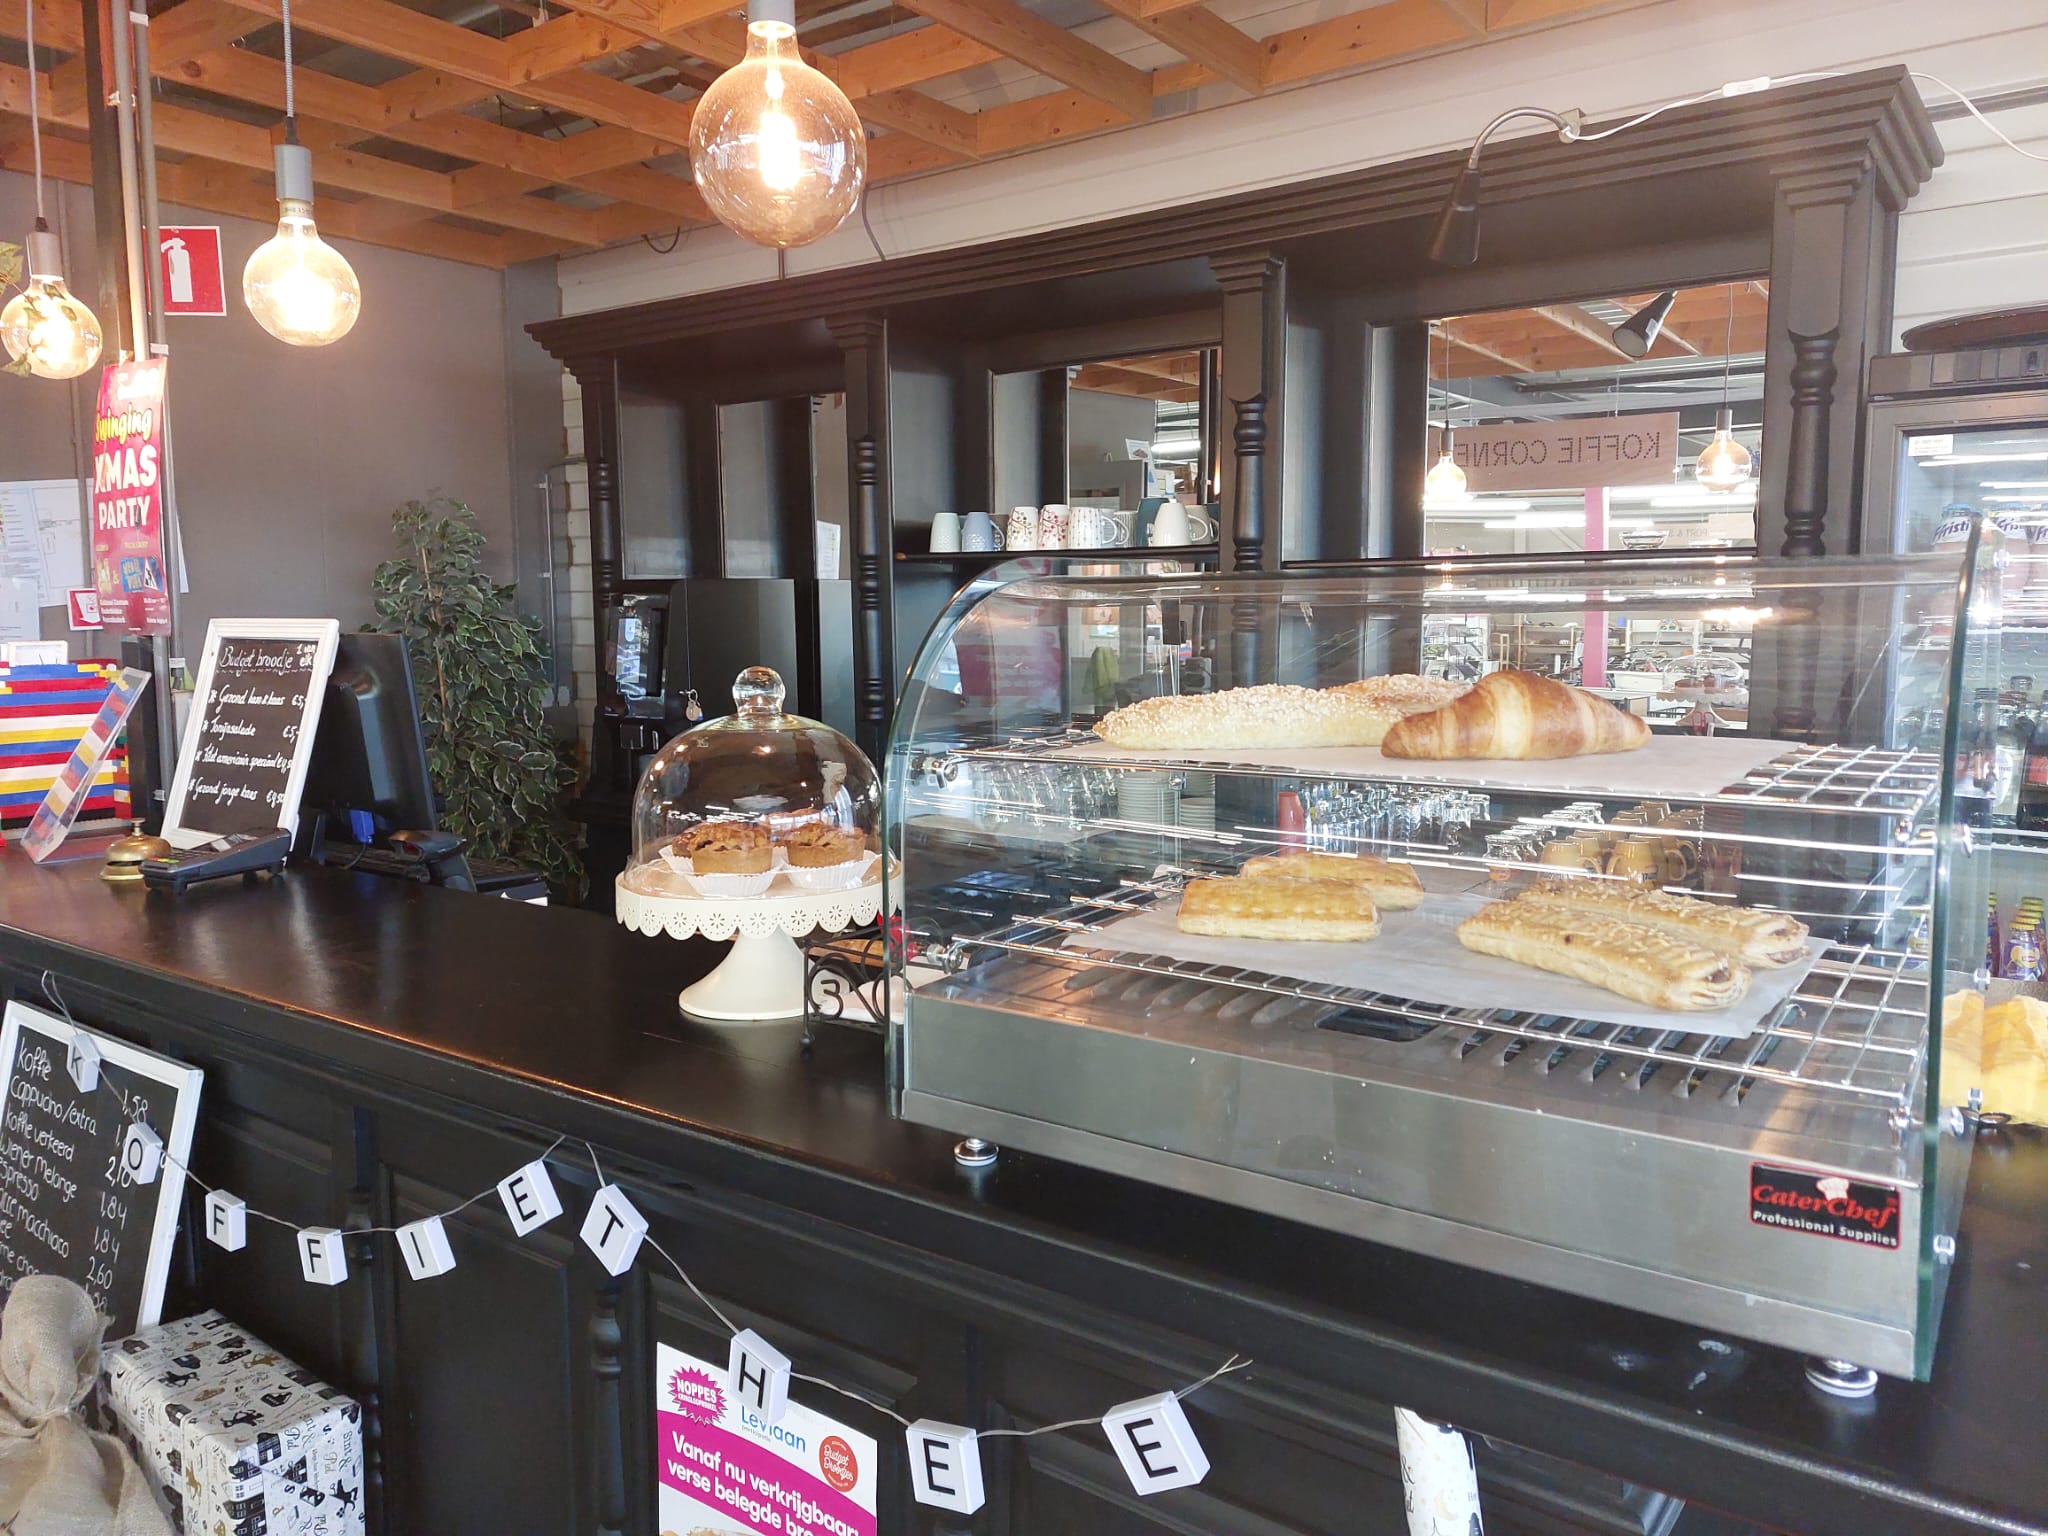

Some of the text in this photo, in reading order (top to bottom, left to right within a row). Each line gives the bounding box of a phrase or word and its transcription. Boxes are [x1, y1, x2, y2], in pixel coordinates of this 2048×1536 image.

[94, 444, 157, 493] XMAS
[98, 496, 151, 531] PARTY
[128, 1137, 143, 1171] O
[212, 1203, 226, 1237] F
[306, 1238, 322, 1274] F
[510, 1176, 538, 1222] E
[1752, 1184, 1897, 1229] CaterChef
[1752, 1211, 1898, 1247] Professional Supplies
[86, 1256, 113, 1290] 2,60
[599, 1205, 1178, 1496] T H E E
[677, 1378, 717, 1404] NOPPES
[671, 1430, 721, 1472] Vanaf
[725, 1462, 746, 1485] nu
[667, 1459, 711, 1493] verse
[714, 1478, 782, 1530] belegde
